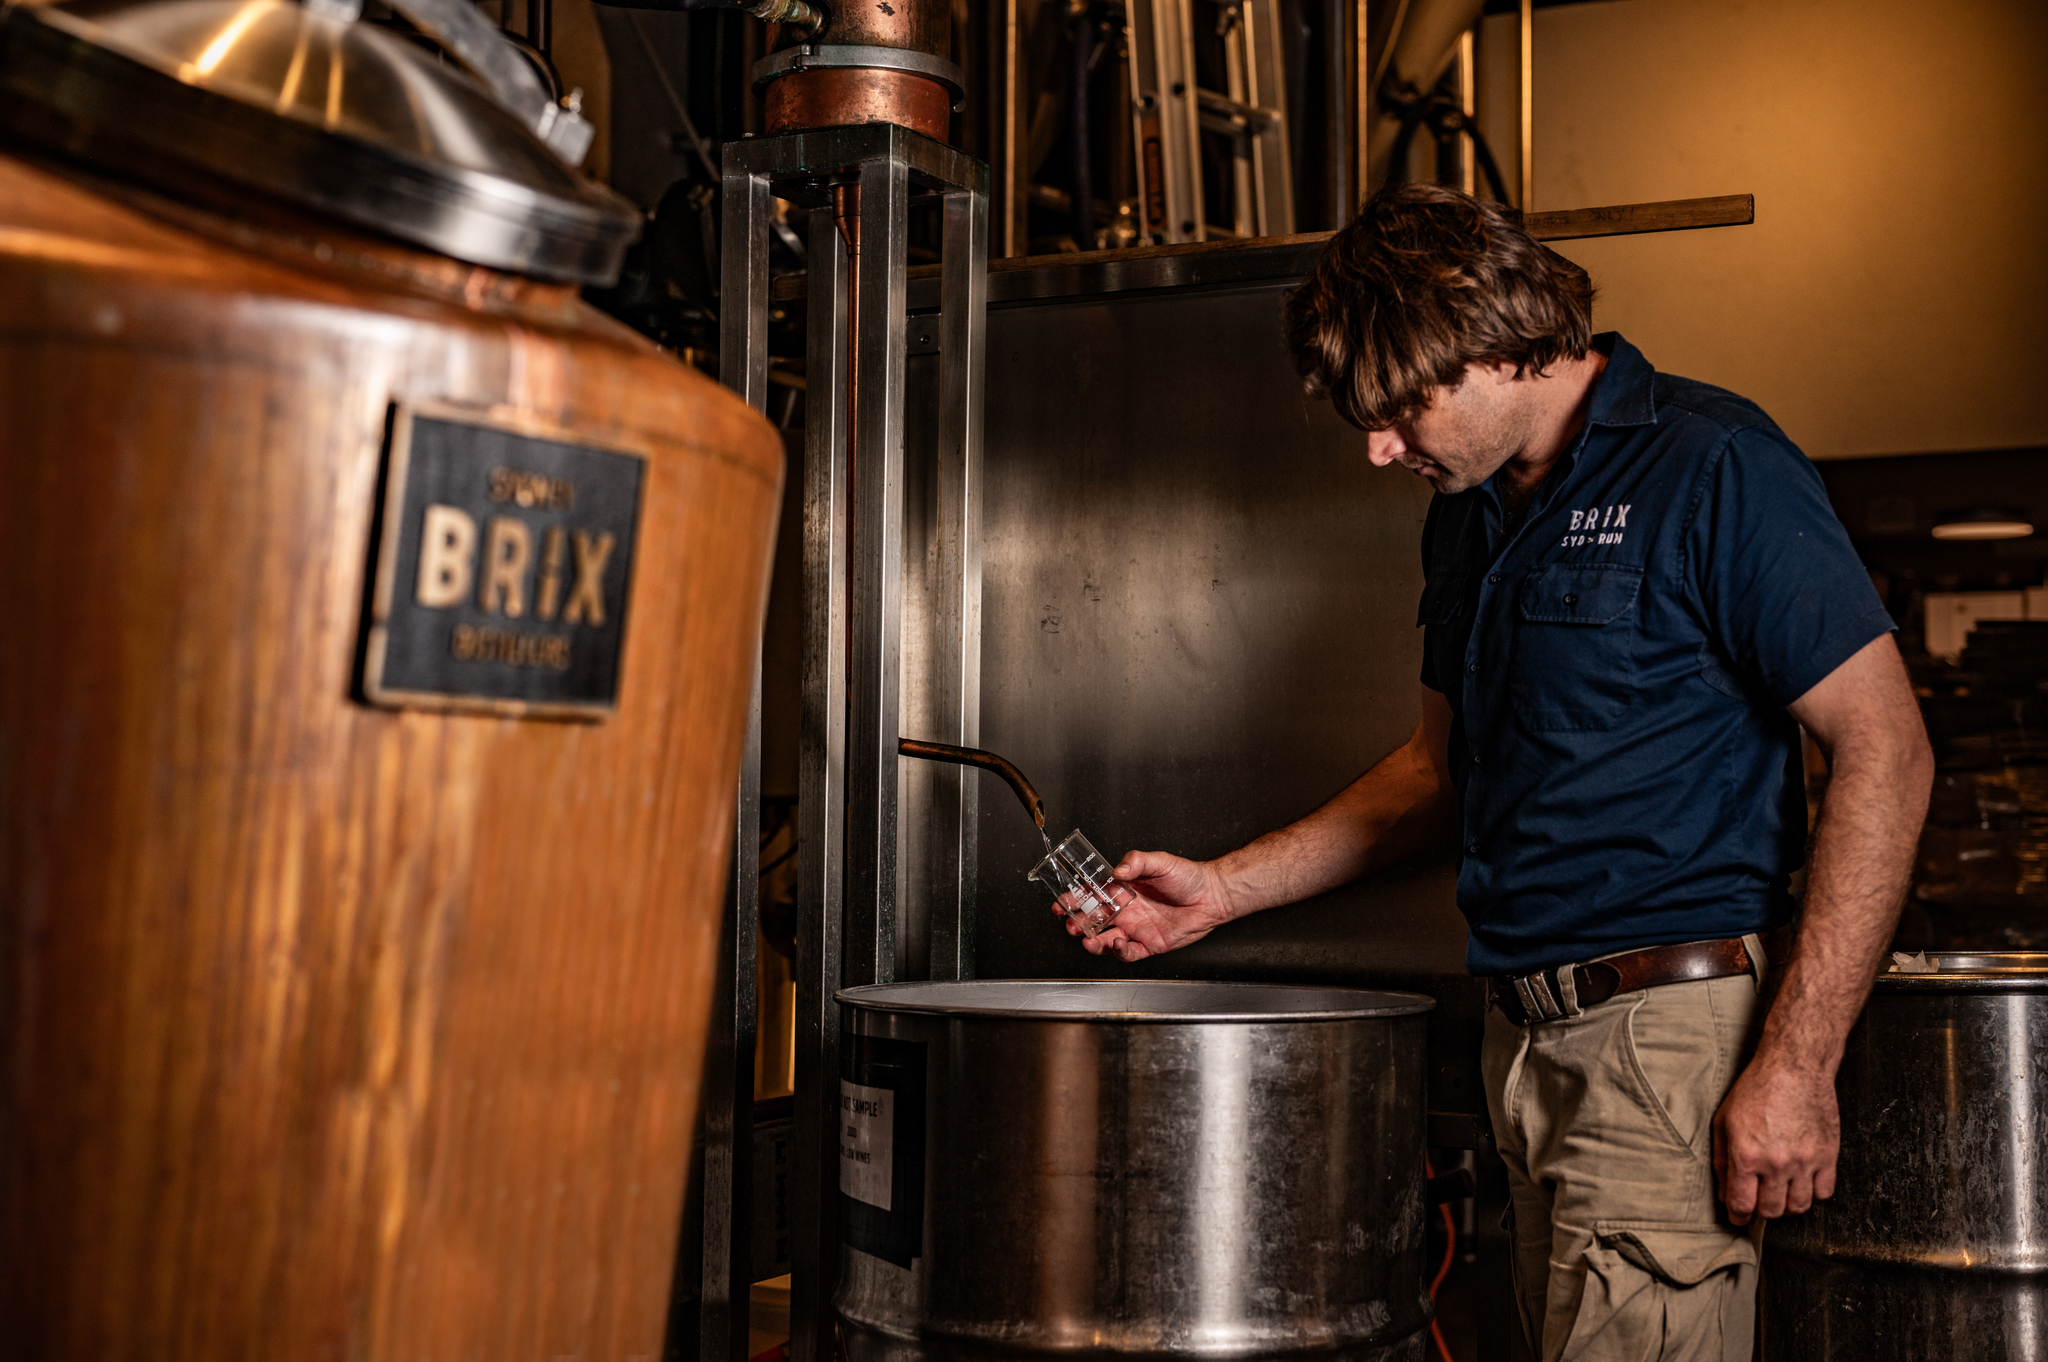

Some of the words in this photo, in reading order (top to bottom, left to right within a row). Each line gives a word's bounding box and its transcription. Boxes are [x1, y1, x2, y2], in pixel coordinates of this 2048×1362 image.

[1569, 504, 1631, 531] BRIX
[1561, 535, 1585, 547] SYD
[1598, 532, 1623, 545] RUM
[416, 503, 615, 627] BRIX
[853, 1098, 877, 1117] SAMPLE
